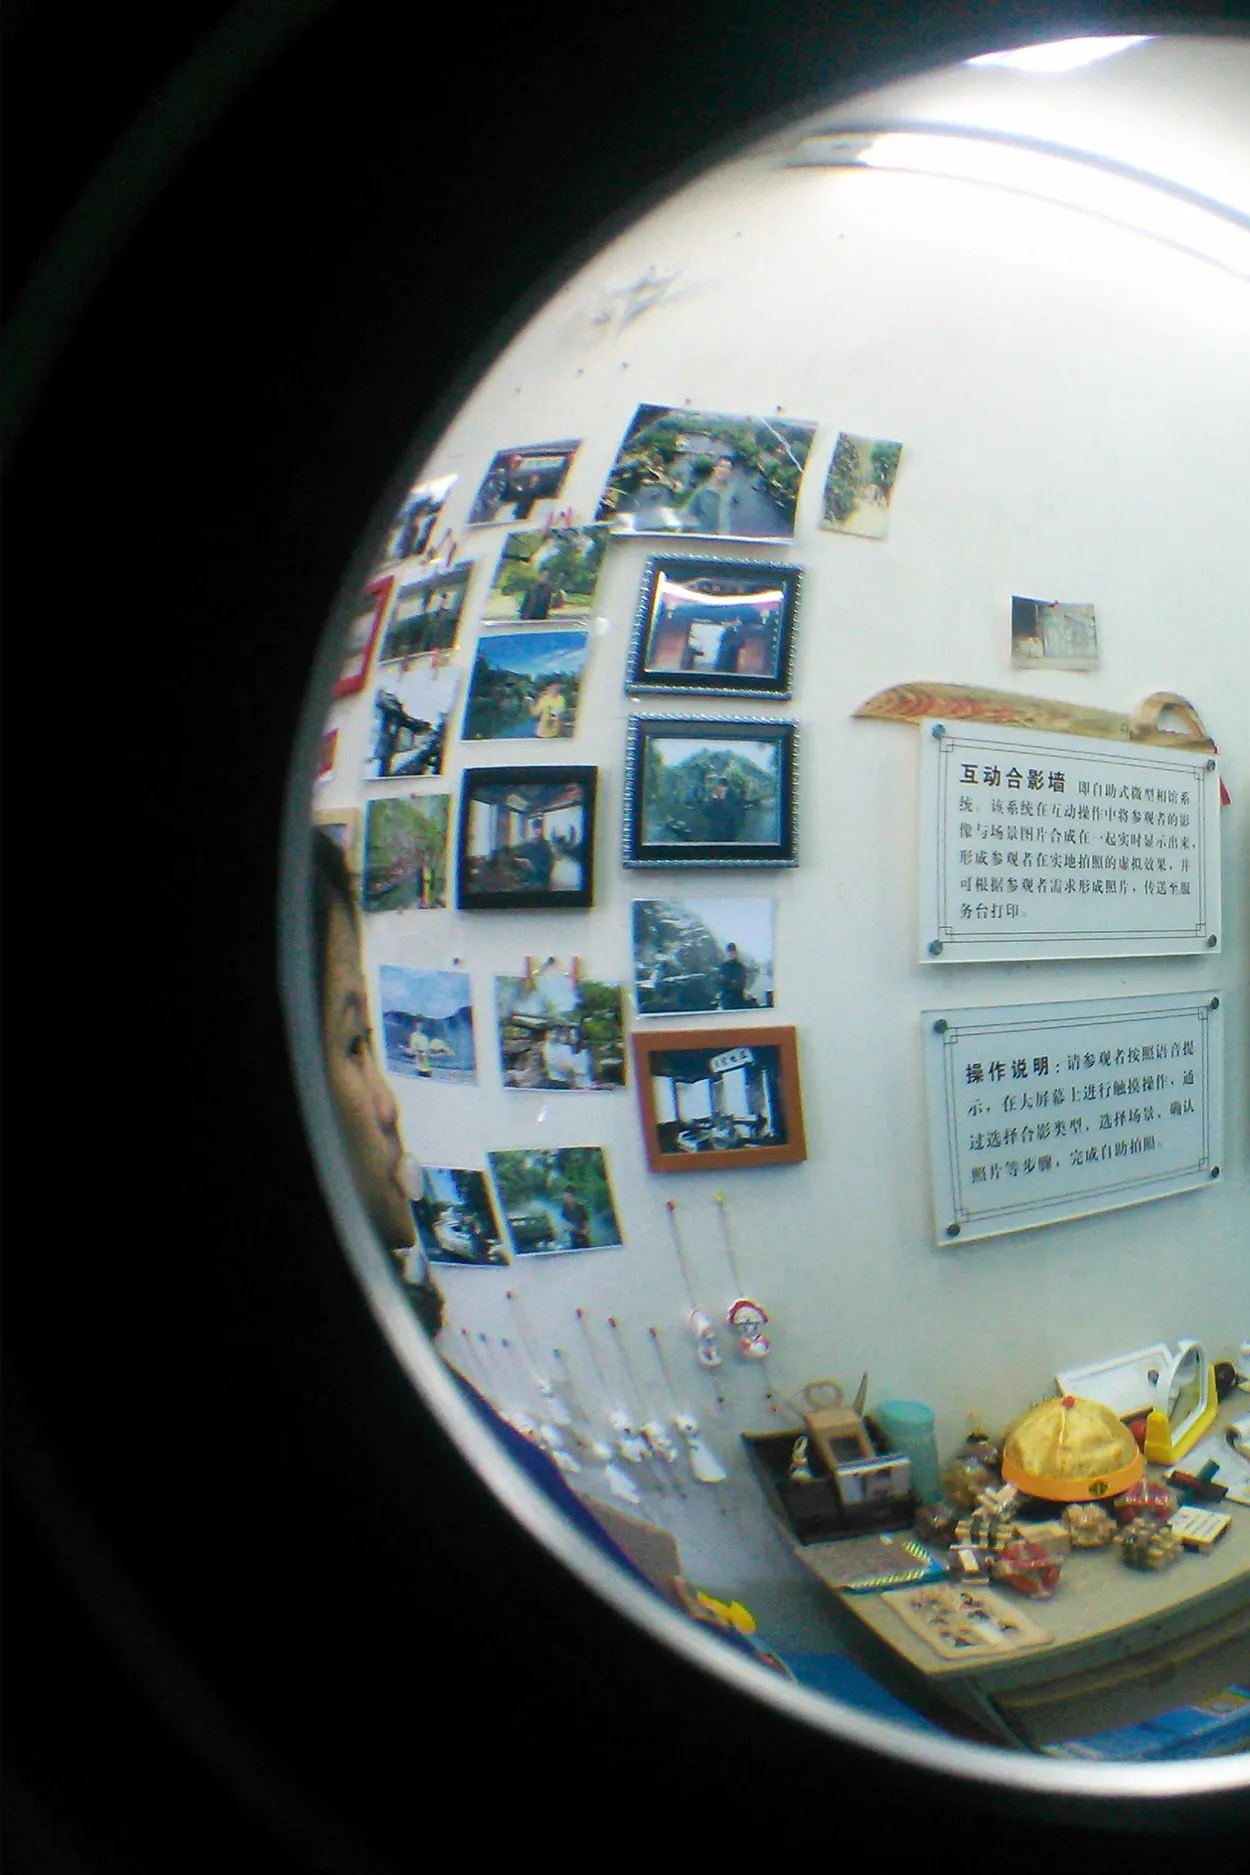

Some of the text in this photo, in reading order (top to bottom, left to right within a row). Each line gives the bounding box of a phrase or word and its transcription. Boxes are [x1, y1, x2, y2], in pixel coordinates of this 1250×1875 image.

[959, 763, 1191, 806] 互动合影墙 即自助式微型相馆系
